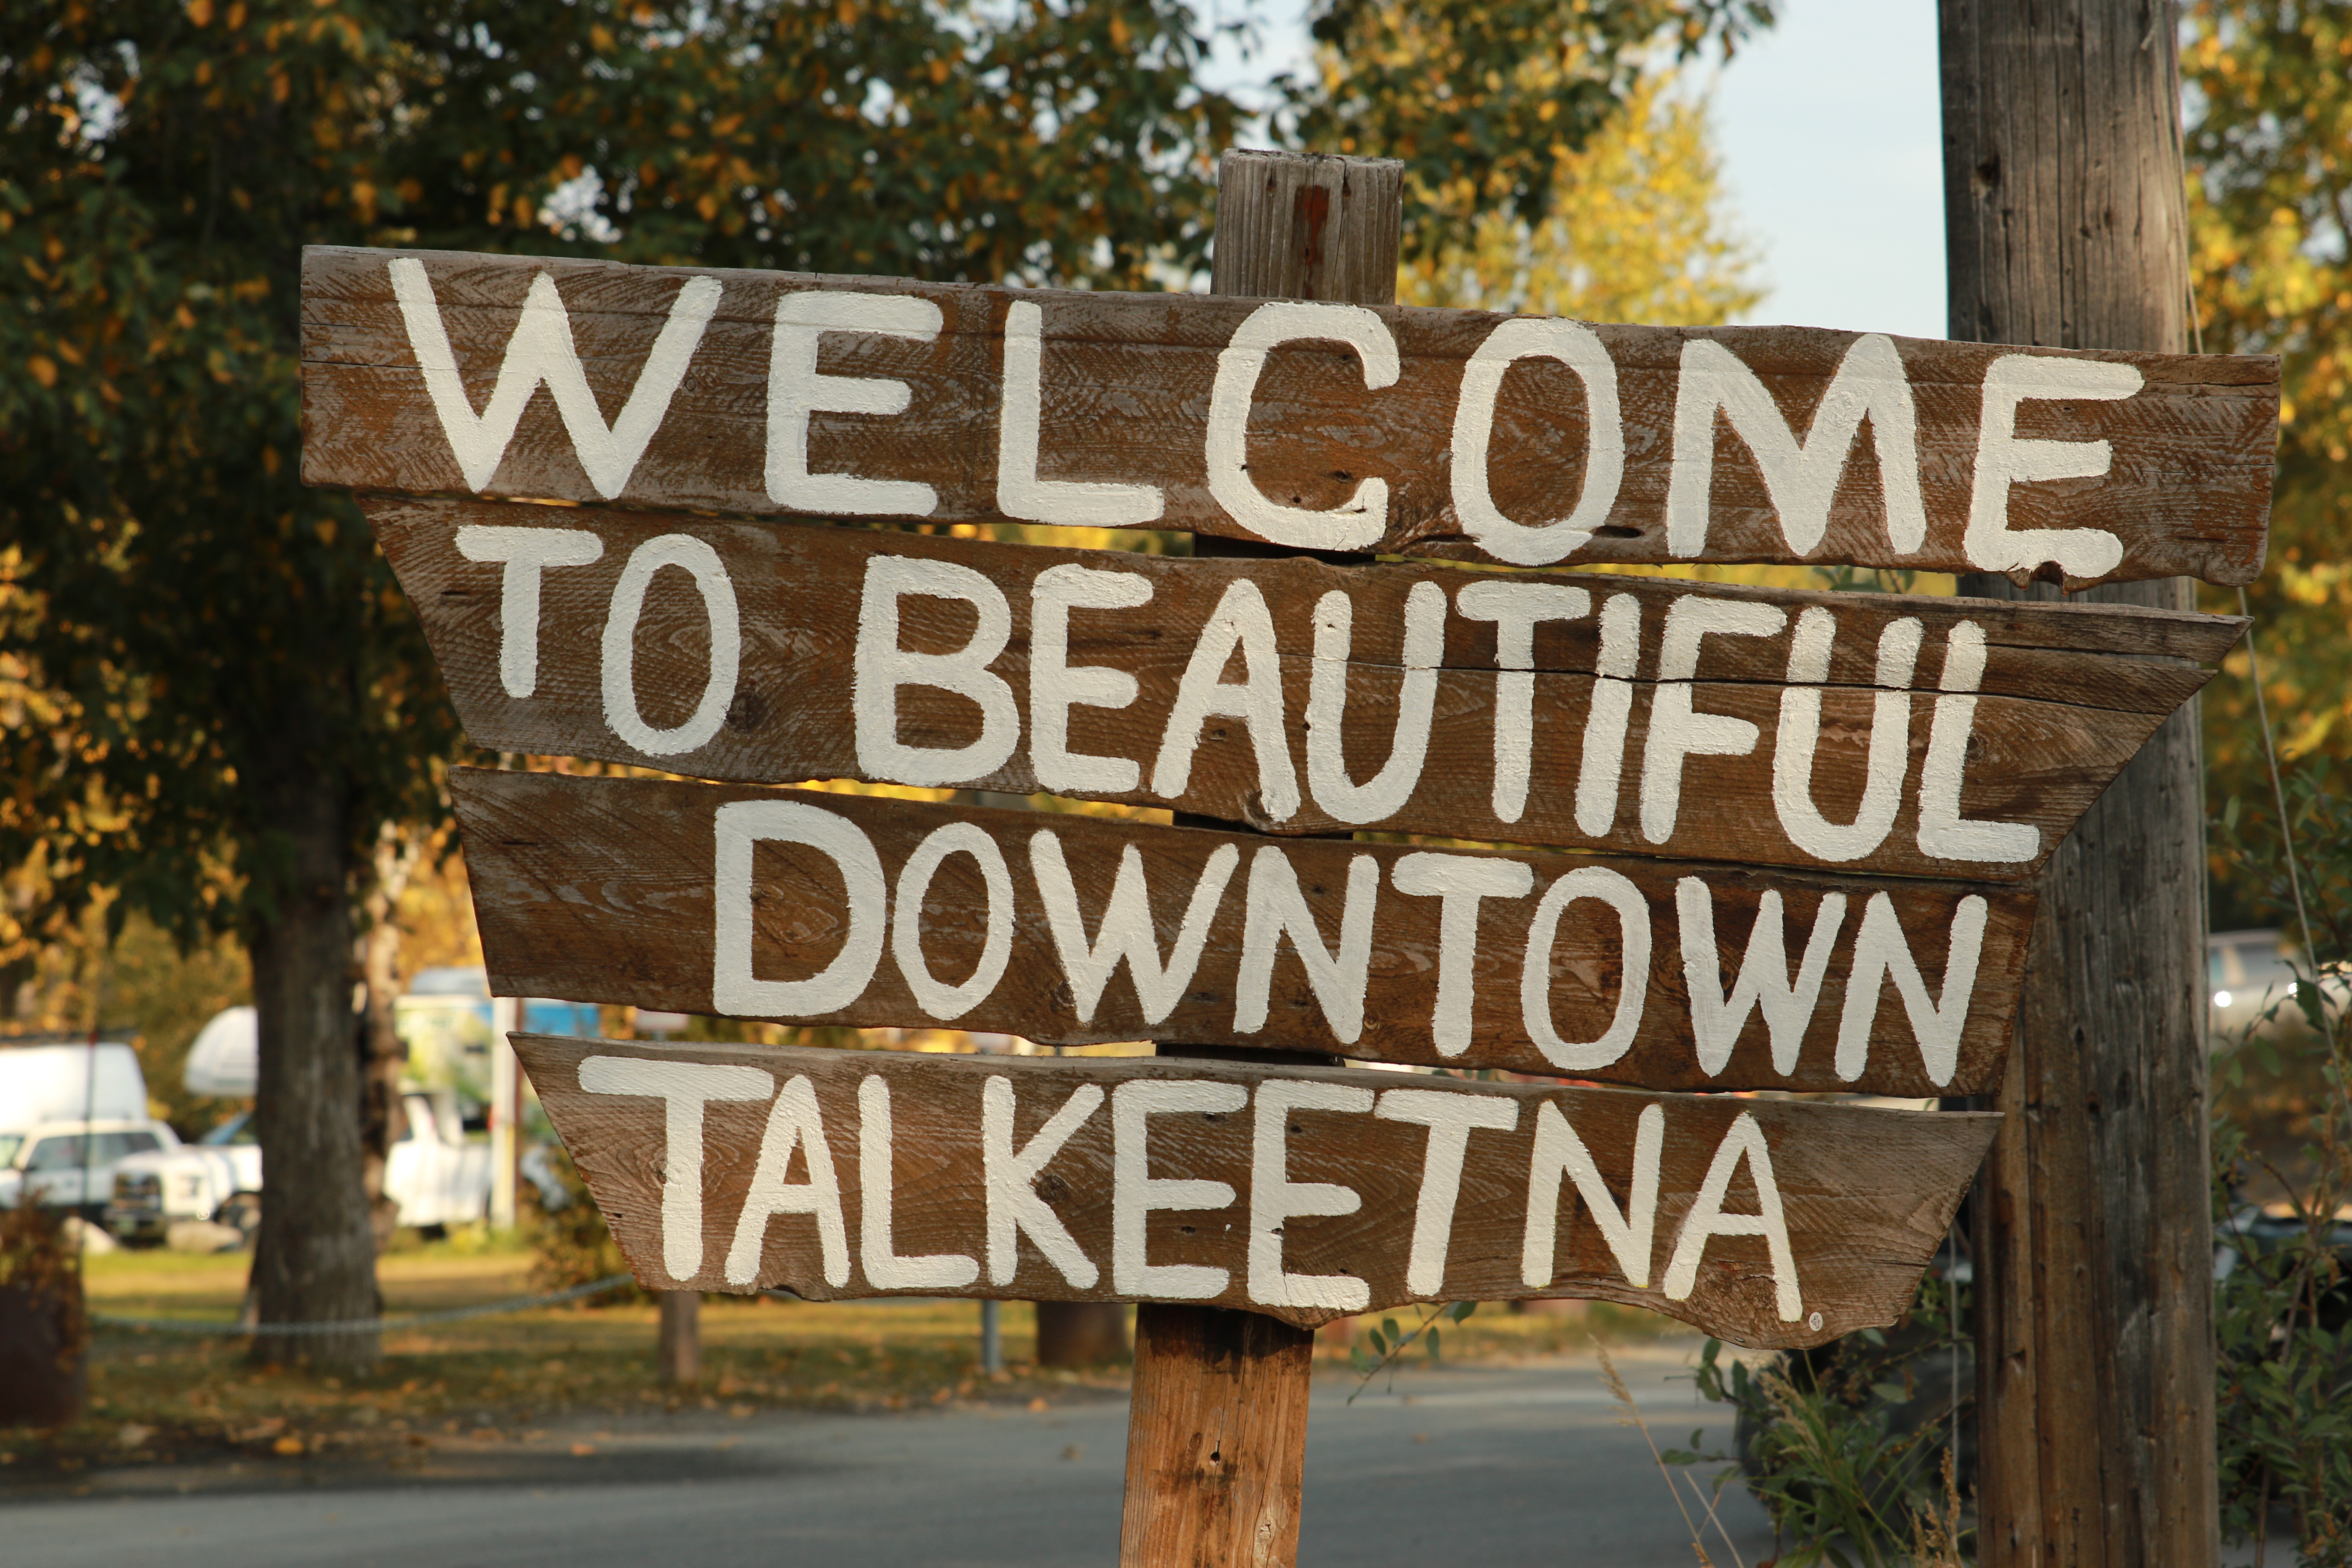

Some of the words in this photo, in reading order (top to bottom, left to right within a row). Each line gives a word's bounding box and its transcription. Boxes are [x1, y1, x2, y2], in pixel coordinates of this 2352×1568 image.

[387, 255, 2146, 579] WELCOME
[454, 524, 742, 757] TO
[852, 554, 2041, 864] BEAUTIFUL
[711, 799, 1988, 1088] DOWNTOWN
[578, 1053, 1803, 1323] TALKEETNA
